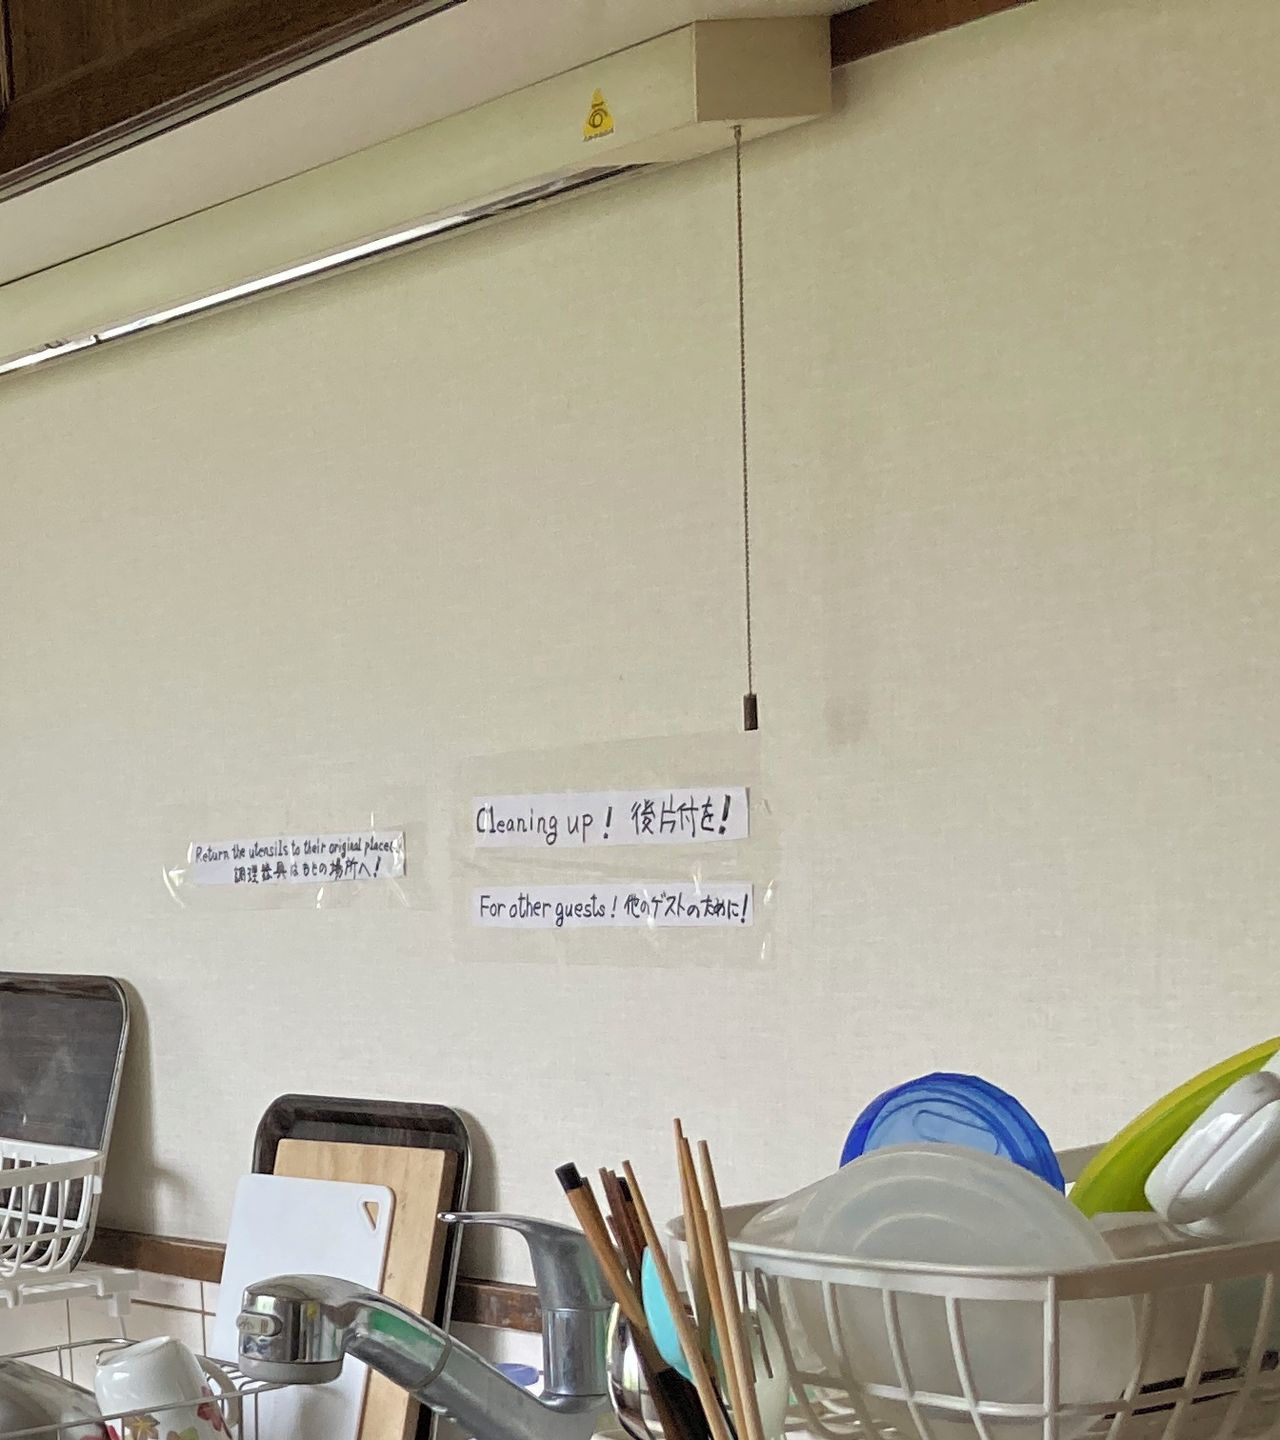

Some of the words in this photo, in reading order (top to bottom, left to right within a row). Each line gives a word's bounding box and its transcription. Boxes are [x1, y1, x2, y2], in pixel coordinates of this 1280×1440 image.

[476, 804, 558, 845] Cleaning
[195, 845, 230, 863] Return
[231, 843, 246, 859] the
[248, 839, 290, 858] utensils
[291, 839, 301, 856] to
[303, 837, 327, 855] their
[328, 836, 362, 859] original
[480, 894, 506, 918] For
[508, 892, 552, 918] other
